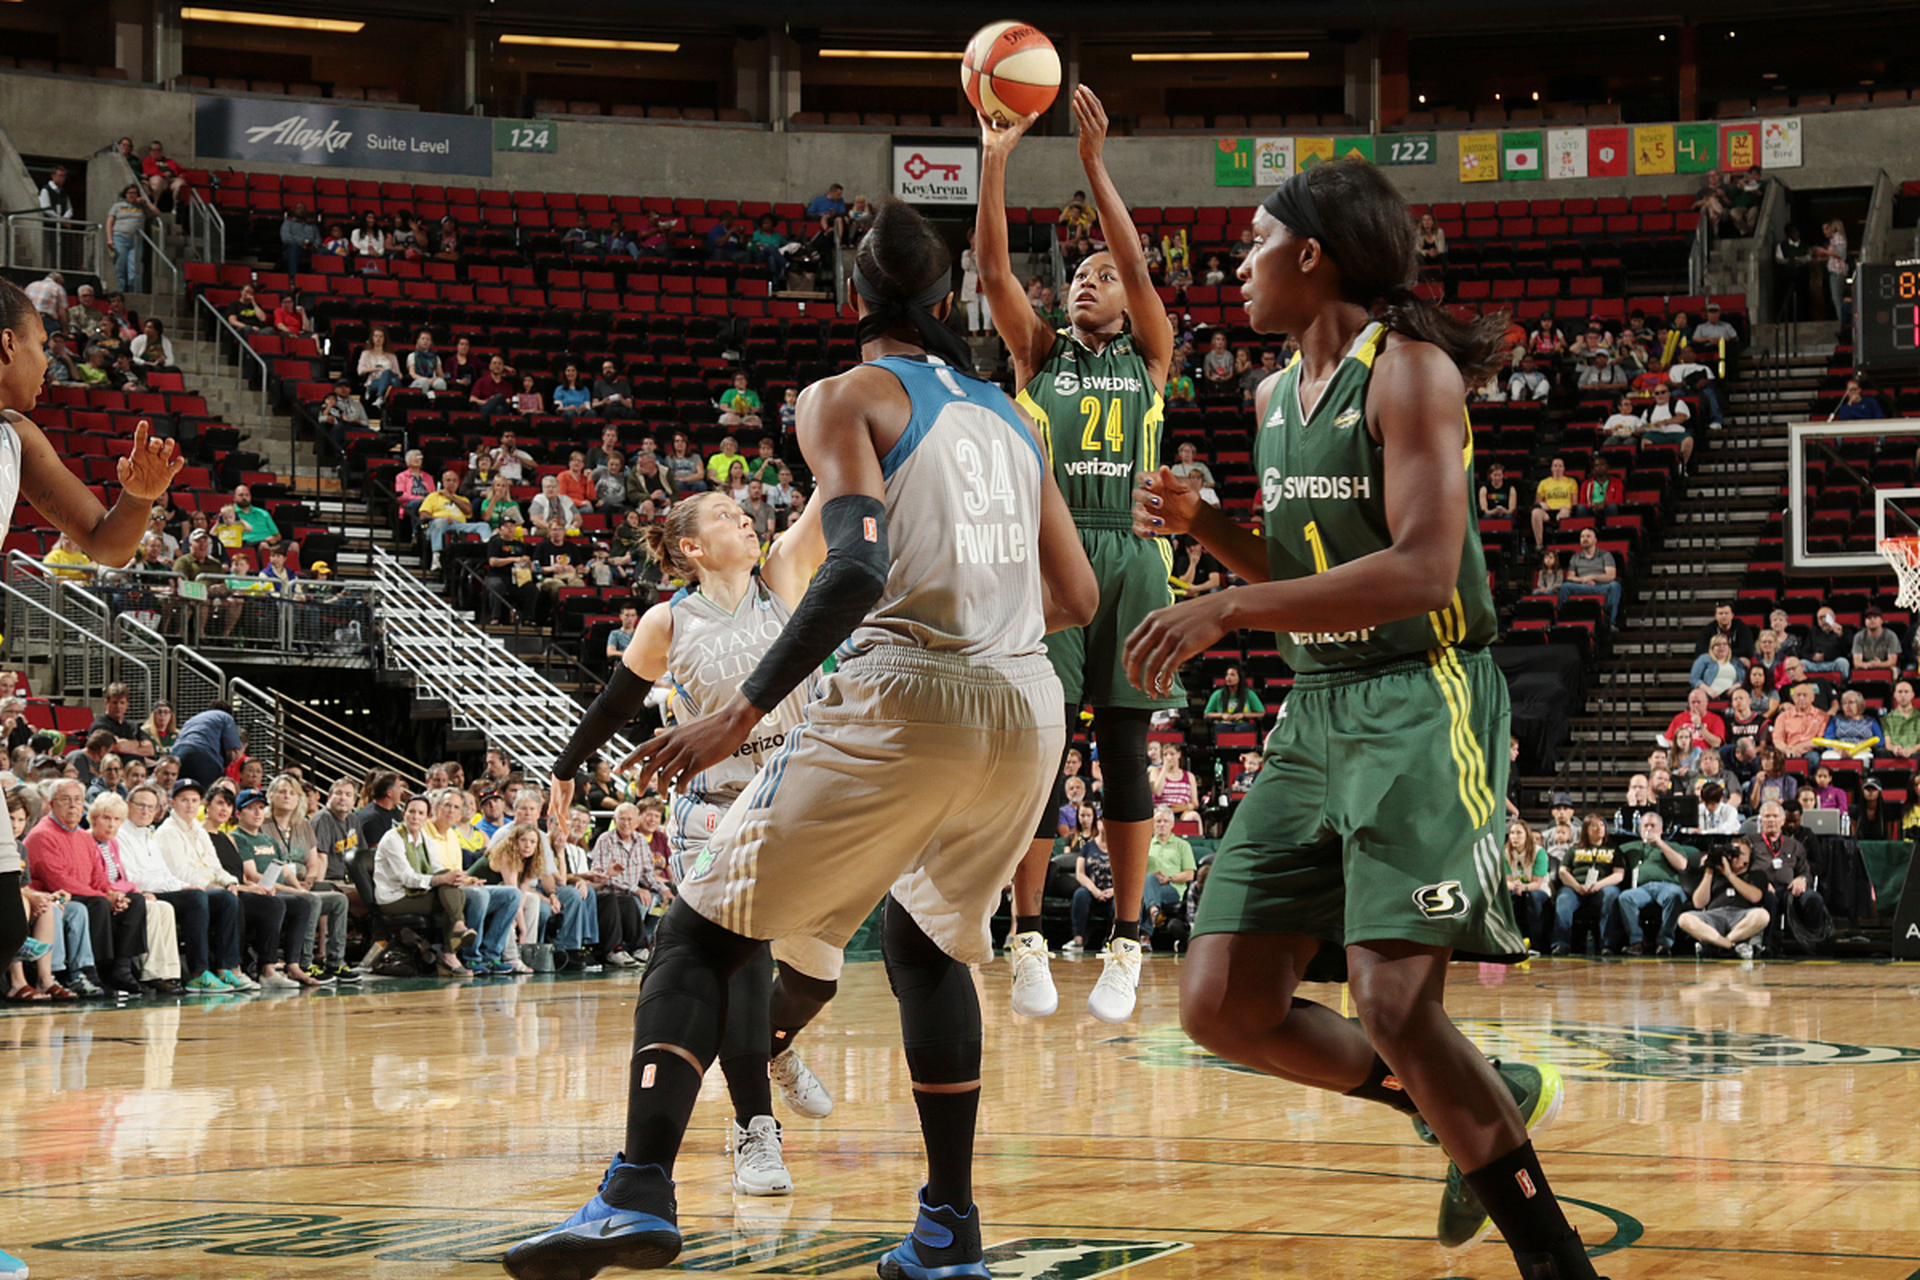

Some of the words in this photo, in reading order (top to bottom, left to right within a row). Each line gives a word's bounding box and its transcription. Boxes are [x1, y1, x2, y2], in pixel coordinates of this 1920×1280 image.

[245, 115, 353, 153] Alaska
[367, 134, 407, 151] Suite
[410, 137, 450, 154] Level
[511, 129, 549, 148] 124
[1734, 137, 1749, 149] 32
[1391, 141, 1430, 161] 122
[1655, 142, 1666, 159] 5
[1678, 138, 1696, 161] 4
[1233, 151, 1247, 169] 11
[1262, 153, 1286, 169] 30
[1479, 166, 1495, 178] 23
[1559, 166, 1576, 177] 24
[902, 182, 968, 197] KeyArena
[1082, 376, 1142, 393] SWEDISH
[1080, 396, 1124, 452] 24
[955, 438, 1016, 516] 34
[1064, 457, 1130, 477] verizon
[1283, 476, 1370, 500] SWEDISH
[1303, 521, 1329, 574] 1
[697, 620, 783, 662] MAYO
